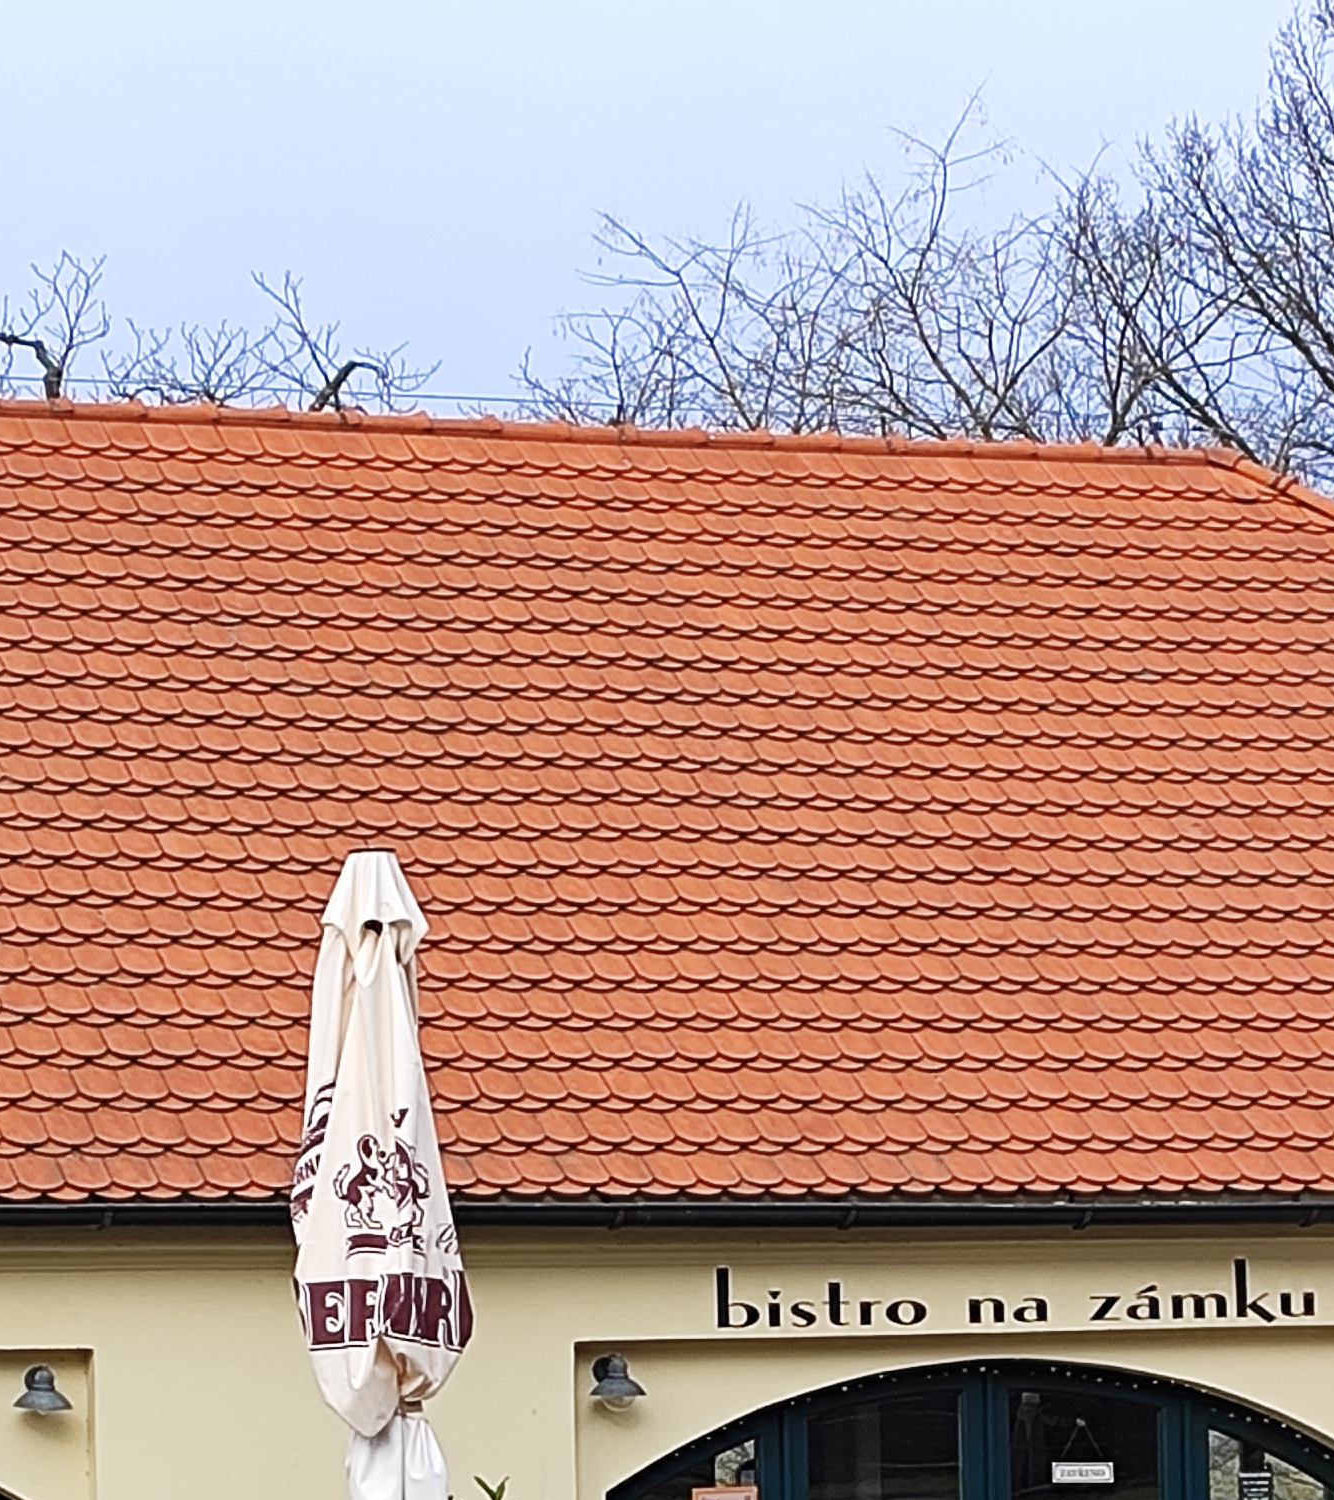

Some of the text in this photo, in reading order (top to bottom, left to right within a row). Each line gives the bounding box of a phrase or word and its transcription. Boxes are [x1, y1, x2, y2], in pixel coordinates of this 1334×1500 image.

[715, 1257, 1316, 1329] bistro na zámku
